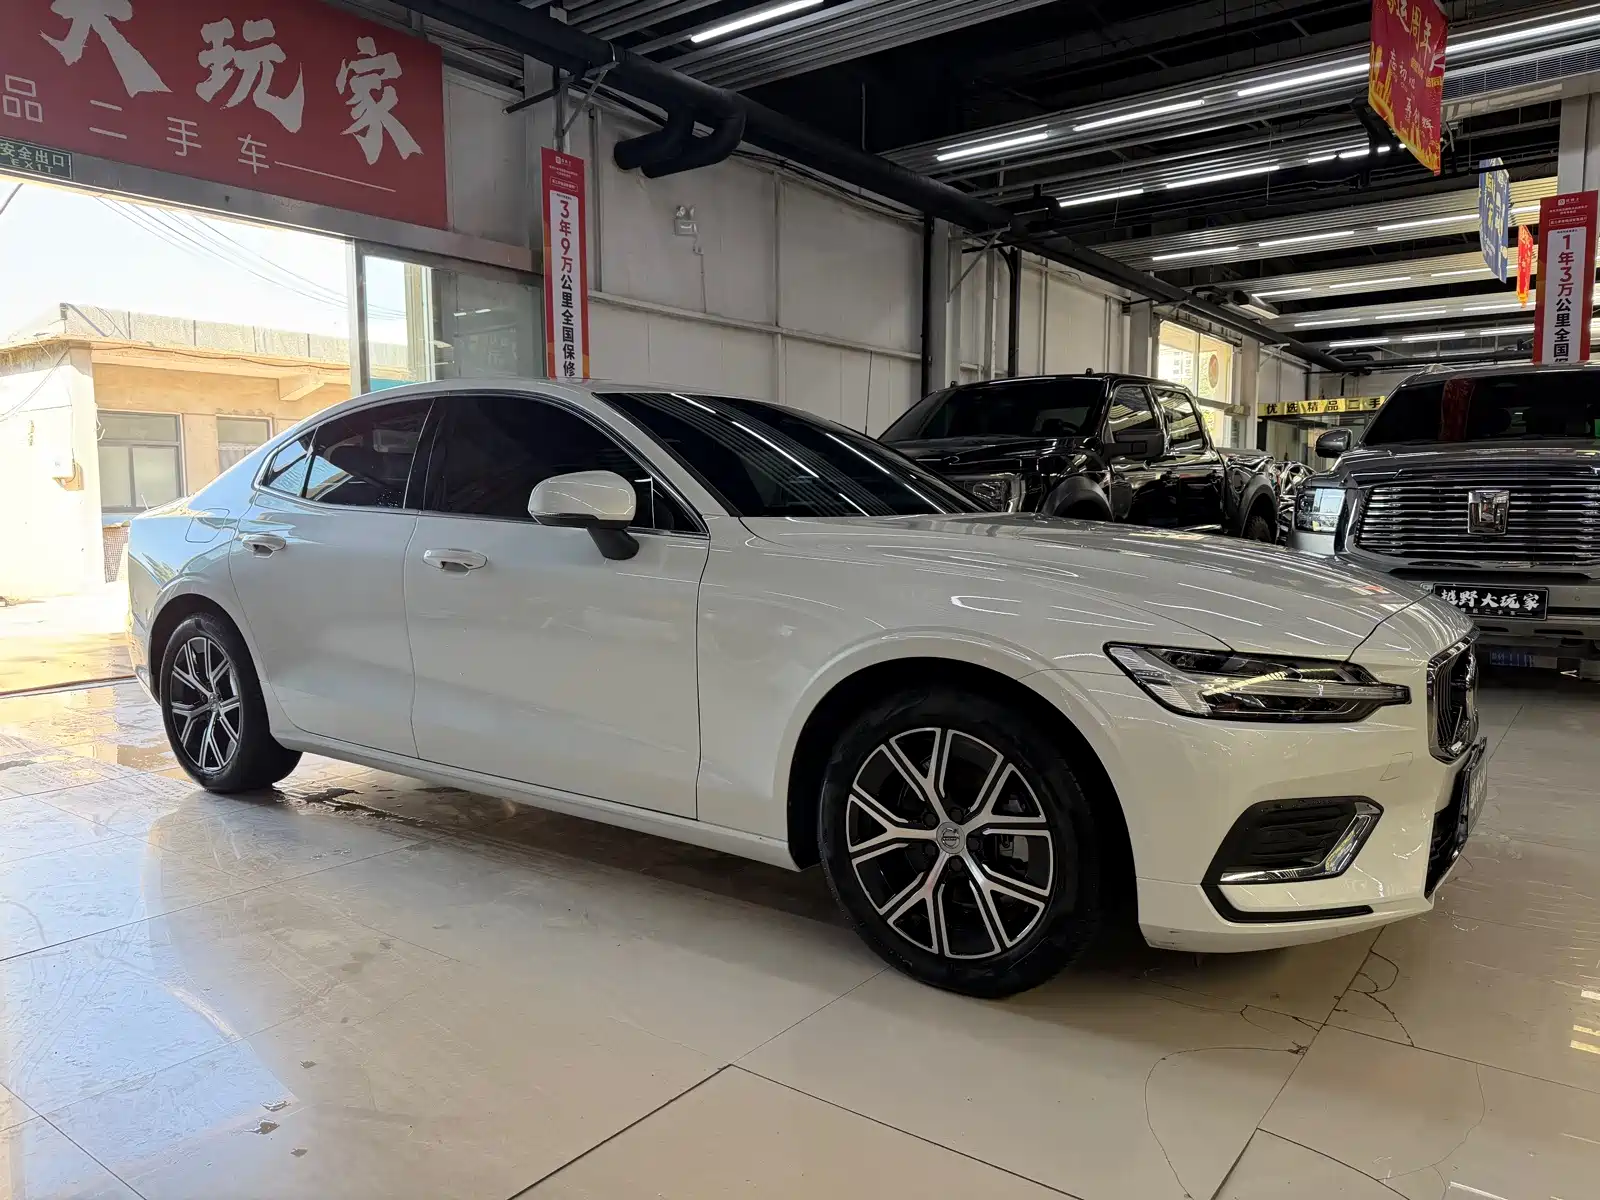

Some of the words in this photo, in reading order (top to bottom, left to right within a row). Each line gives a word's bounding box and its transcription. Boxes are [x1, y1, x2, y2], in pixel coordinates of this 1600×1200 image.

[40, 0, 424, 165] 大玩家
[0, 142, 64, 167] 安全出口
[3, 74, 270, 174] 品二手车
[10, 158, 54, 173] EXIT
[559, 200, 575, 377] 3年9万公里全国保修
[1553, 234, 1575, 363] 1年3万公里全国
[1266, 398, 1381, 414] 优选精品二手
[1441, 589, 1540, 611] 越野大玩家
